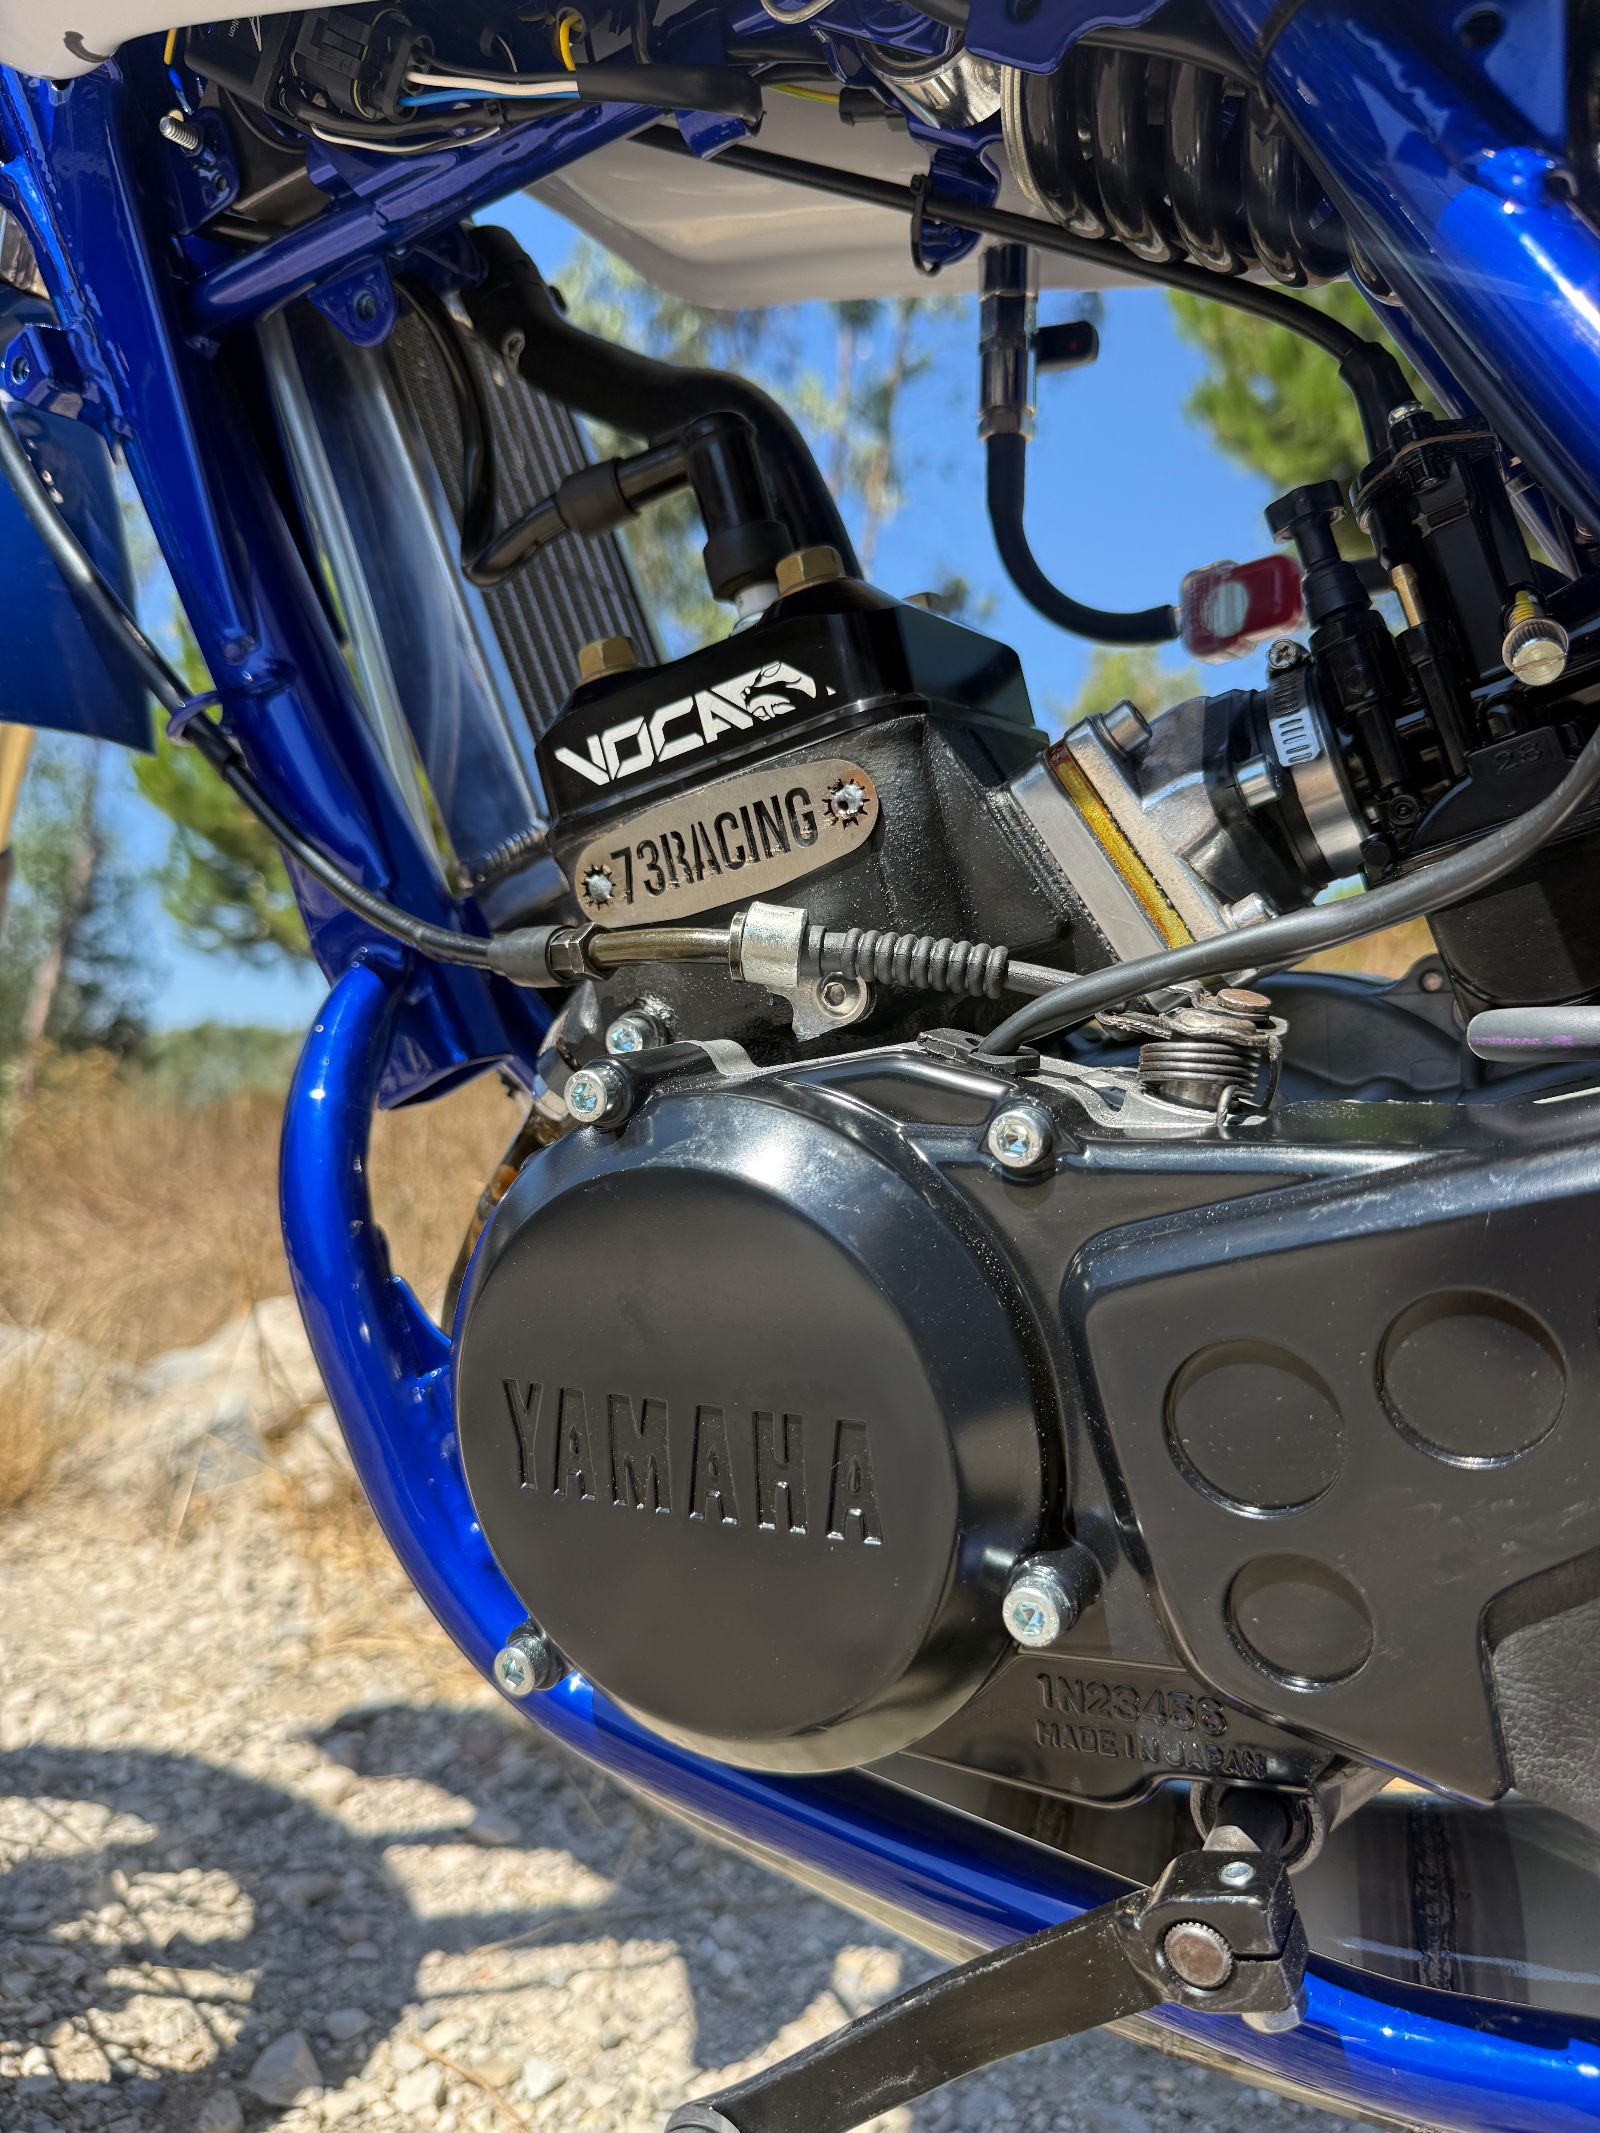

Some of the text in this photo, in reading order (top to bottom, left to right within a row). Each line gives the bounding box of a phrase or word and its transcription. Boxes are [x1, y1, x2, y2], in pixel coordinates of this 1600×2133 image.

[1493, 741, 1542, 774] 28
[611, 787, 820, 905] 73RACING
[503, 1378, 884, 1545] YAMAHA
[1036, 1672, 1228, 1736] 1N23456
[1036, 1719, 1267, 1780] MADE IN JAPAN
